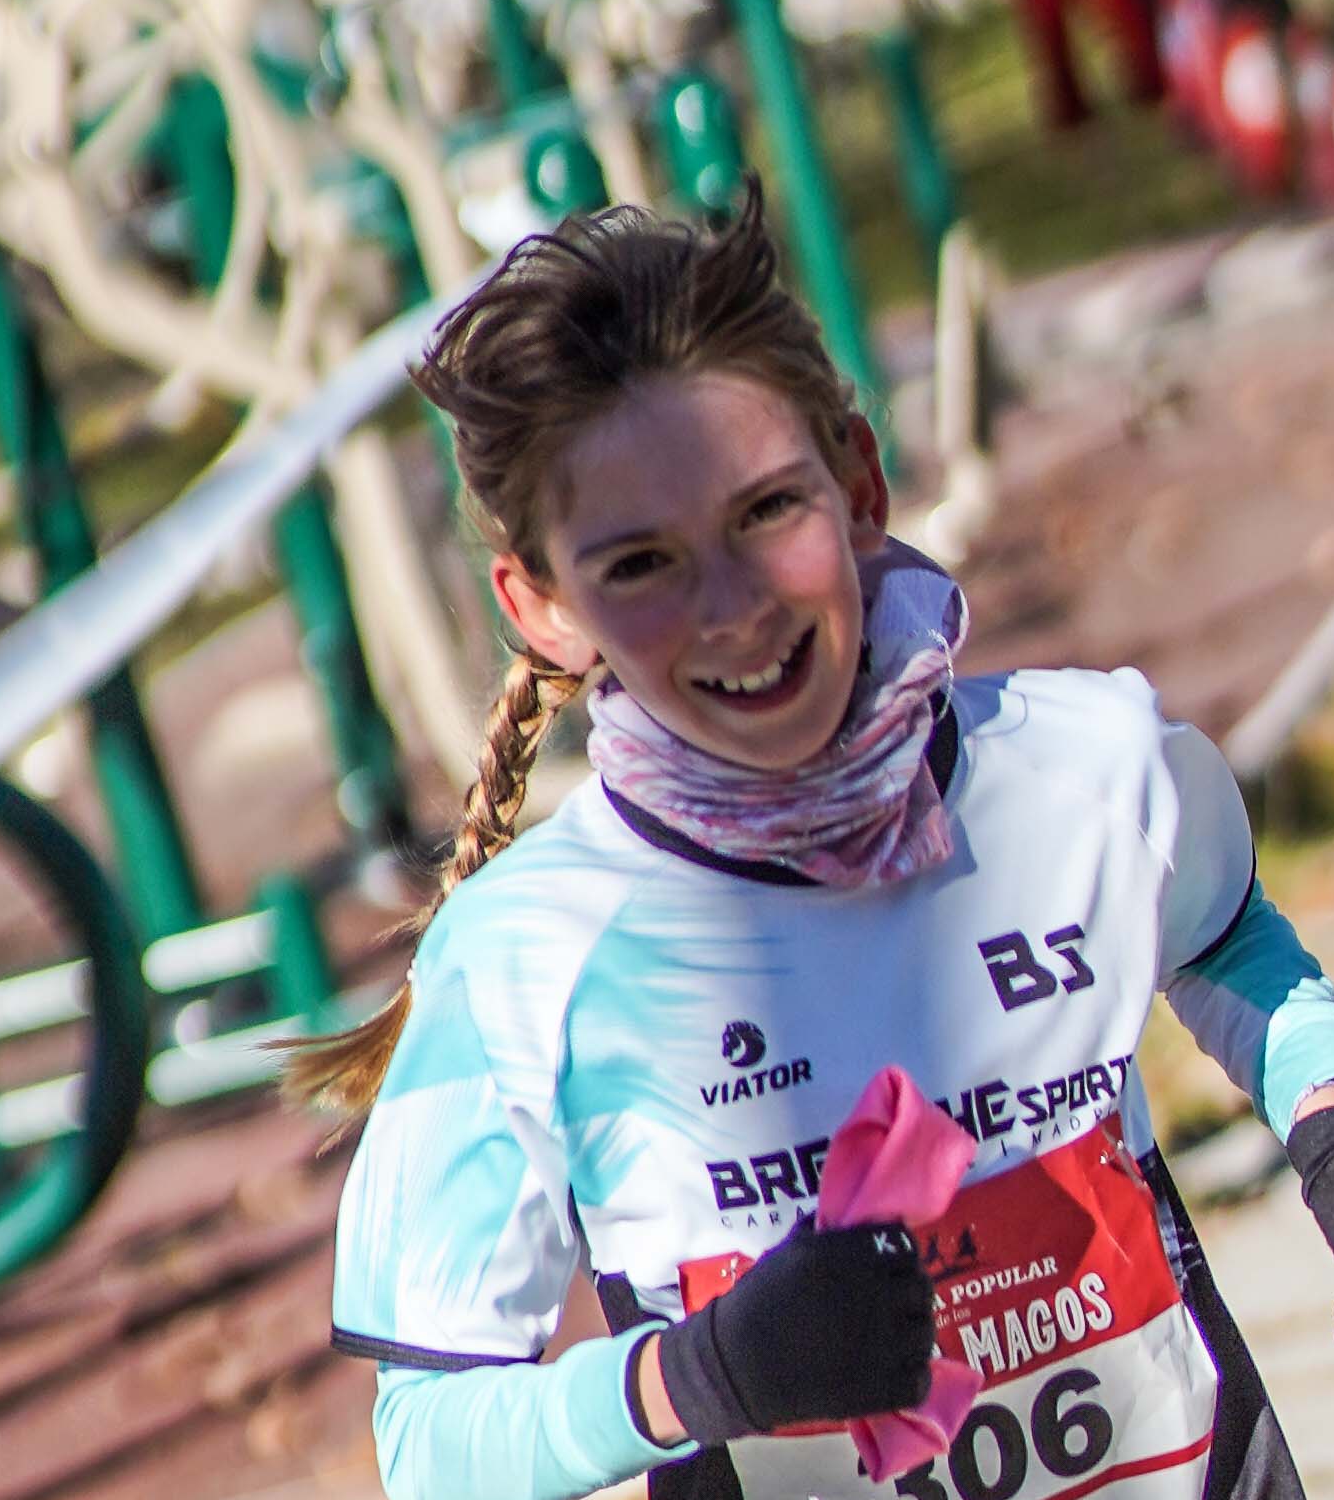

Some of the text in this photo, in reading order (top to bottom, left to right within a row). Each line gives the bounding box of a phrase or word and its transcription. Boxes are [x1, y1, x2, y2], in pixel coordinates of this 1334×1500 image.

[977, 923, 1095, 1012] BS
[700, 1057, 813, 1107] VIATOR
[950, 1256, 1058, 1304] POPULAR
[958, 1272, 1113, 1378] MAGOS
